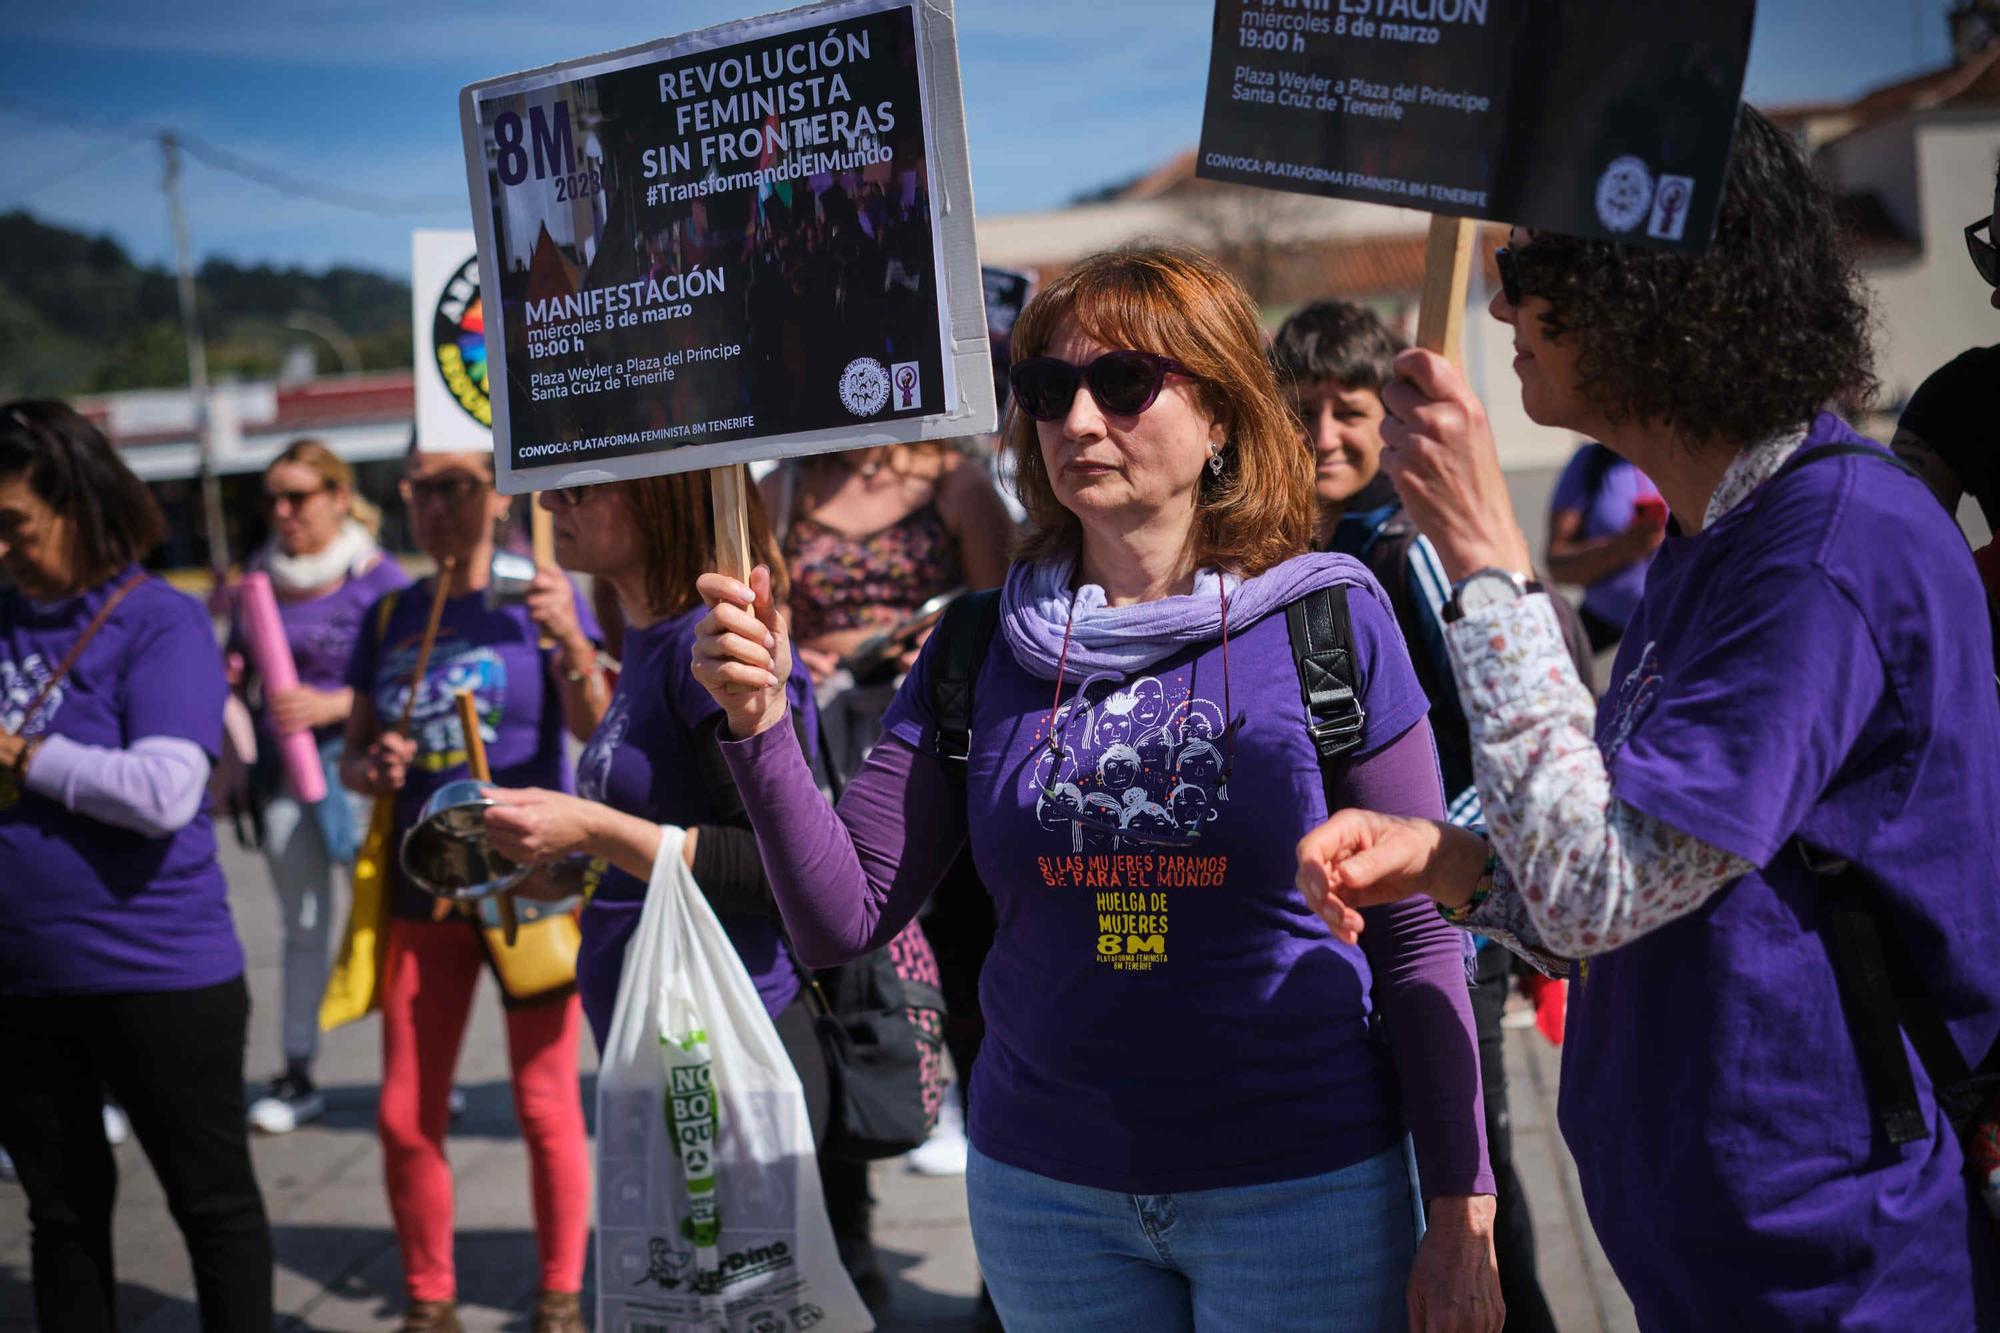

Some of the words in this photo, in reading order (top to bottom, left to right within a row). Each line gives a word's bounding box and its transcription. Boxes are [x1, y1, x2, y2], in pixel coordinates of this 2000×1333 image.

[1238, 28, 1288, 50] 19:00
[1292, 32, 1305, 53] h
[1240, 9, 1330, 34] miércoles
[1334, 15, 1346, 35] 8
[1351, 17, 1375, 37] de
[1379, 24, 1440, 44] marzo
[658, 28, 871, 103] REVOLUCIÓN
[1232, 84, 1275, 105] Santa
[1279, 89, 1312, 108] Cruz
[1316, 93, 1337, 111] de
[1342, 97, 1404, 120] Tenerife
[1235, 66, 1275, 86] Plaza
[1279, 71, 1331, 94] Weyler
[1334, 81, 1345, 94] a
[1350, 78, 1389, 99] Plaza
[1392, 83, 1417, 103] del
[676, 73, 851, 136] FEMINISTA
[494, 100, 577, 186] 8M
[641, 141, 691, 179] SIN
[700, 101, 896, 168] FRONTERAS
[555, 171, 601, 203] 2023
[646, 142, 893, 207] #TransformandoElMundo
[1206, 153, 1263, 174] CONVOCA:
[1264, 161, 1344, 186] PLATAFORMA
[1346, 173, 1406, 194] FEMINISTA
[1429, 184, 1488, 208] TENERIFE
[525, 264, 726, 327] MANIFESTACIÓN
[528, 317, 602, 342] miércoles
[605, 313, 615, 330] 8
[618, 307, 639, 328] de
[642, 303, 693, 323] marzo
[528, 339, 570, 359] 19:00
[574, 336, 585, 352] h
[531, 373, 565, 387] Plaza
[567, 363, 613, 384] Weyler
[616, 362, 624, 374] a
[627, 356, 661, 373] Plaza
[663, 349, 684, 367] del
[687, 343, 742, 362] Príncipe
[531, 382, 568, 401] Santa
[571, 381, 602, 396] Cruz
[605, 372, 621, 390] de
[624, 367, 675, 388] Tenerife
[519, 442, 572, 459] CONVOCA:
[573, 432, 640, 451] PLATAFORMA
[641, 424, 691, 442] FEMINISTA
[692, 424, 707, 435] 8M
[708, 415, 755, 433] TENERIFE
[1038, 855, 1053, 873] SI
[1056, 856, 1084, 872] LAS
[1088, 855, 1154, 872] MUJERES
[1158, 855, 1227, 873] PARAMOS
[1043, 871, 1067, 887] SE
[1073, 872, 1121, 888] PARA
[1127, 871, 1149, 887] EL
[1157, 871, 1225, 888] MUNDO
[1096, 892, 1146, 913] HUELGA
[1151, 893, 1168, 913] DE
[1099, 914, 1168, 934] MUJERES
[1096, 934, 1165, 955] 8M
[1096, 954, 1135, 963] PLATAFORMA
[1136, 954, 1168, 963] FEMINISTA
[1125, 961, 1152, 971] TENERIFE
